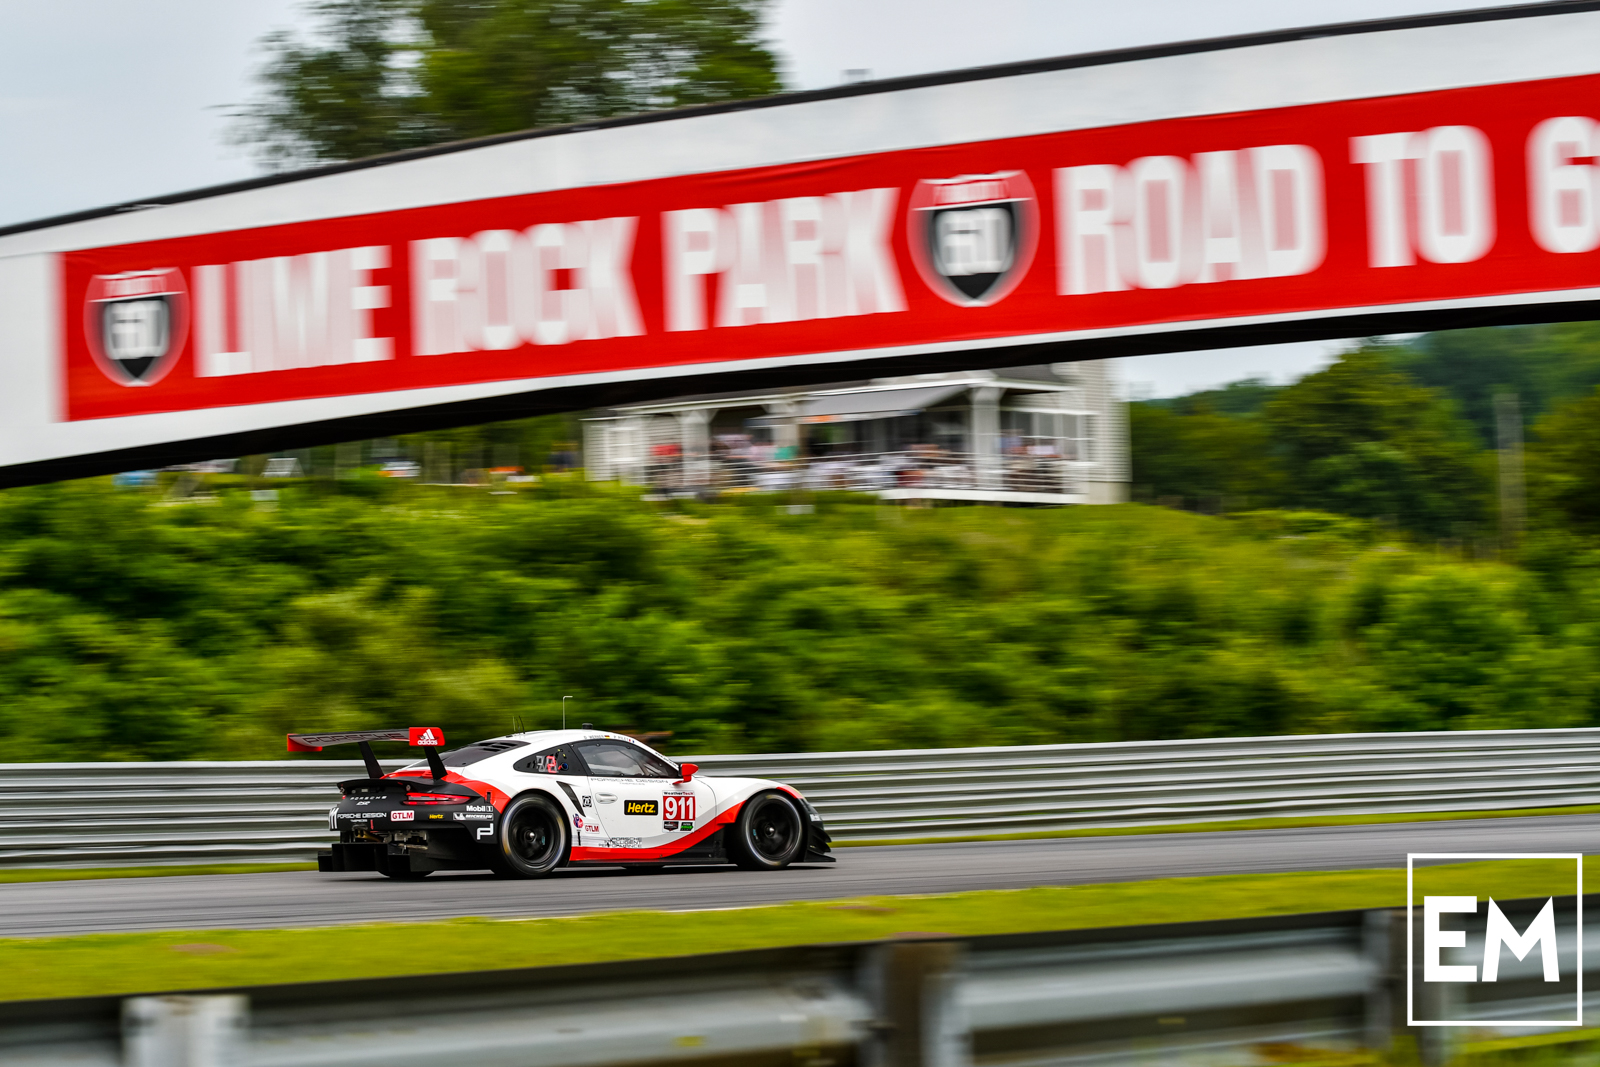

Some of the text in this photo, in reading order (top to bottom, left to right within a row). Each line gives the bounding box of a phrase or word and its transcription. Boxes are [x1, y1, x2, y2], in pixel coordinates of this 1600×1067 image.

[192, 245, 395, 377] LIME
[409, 216, 648, 356] ROCK
[660, 187, 909, 332] PARK
[1052, 144, 1327, 296] ROAD
[1348, 125, 1498, 268] TO
[302, 732, 408, 745] PORSCHE
[391, 811, 413, 820] GTLM
[665, 796, 694, 820] 911
